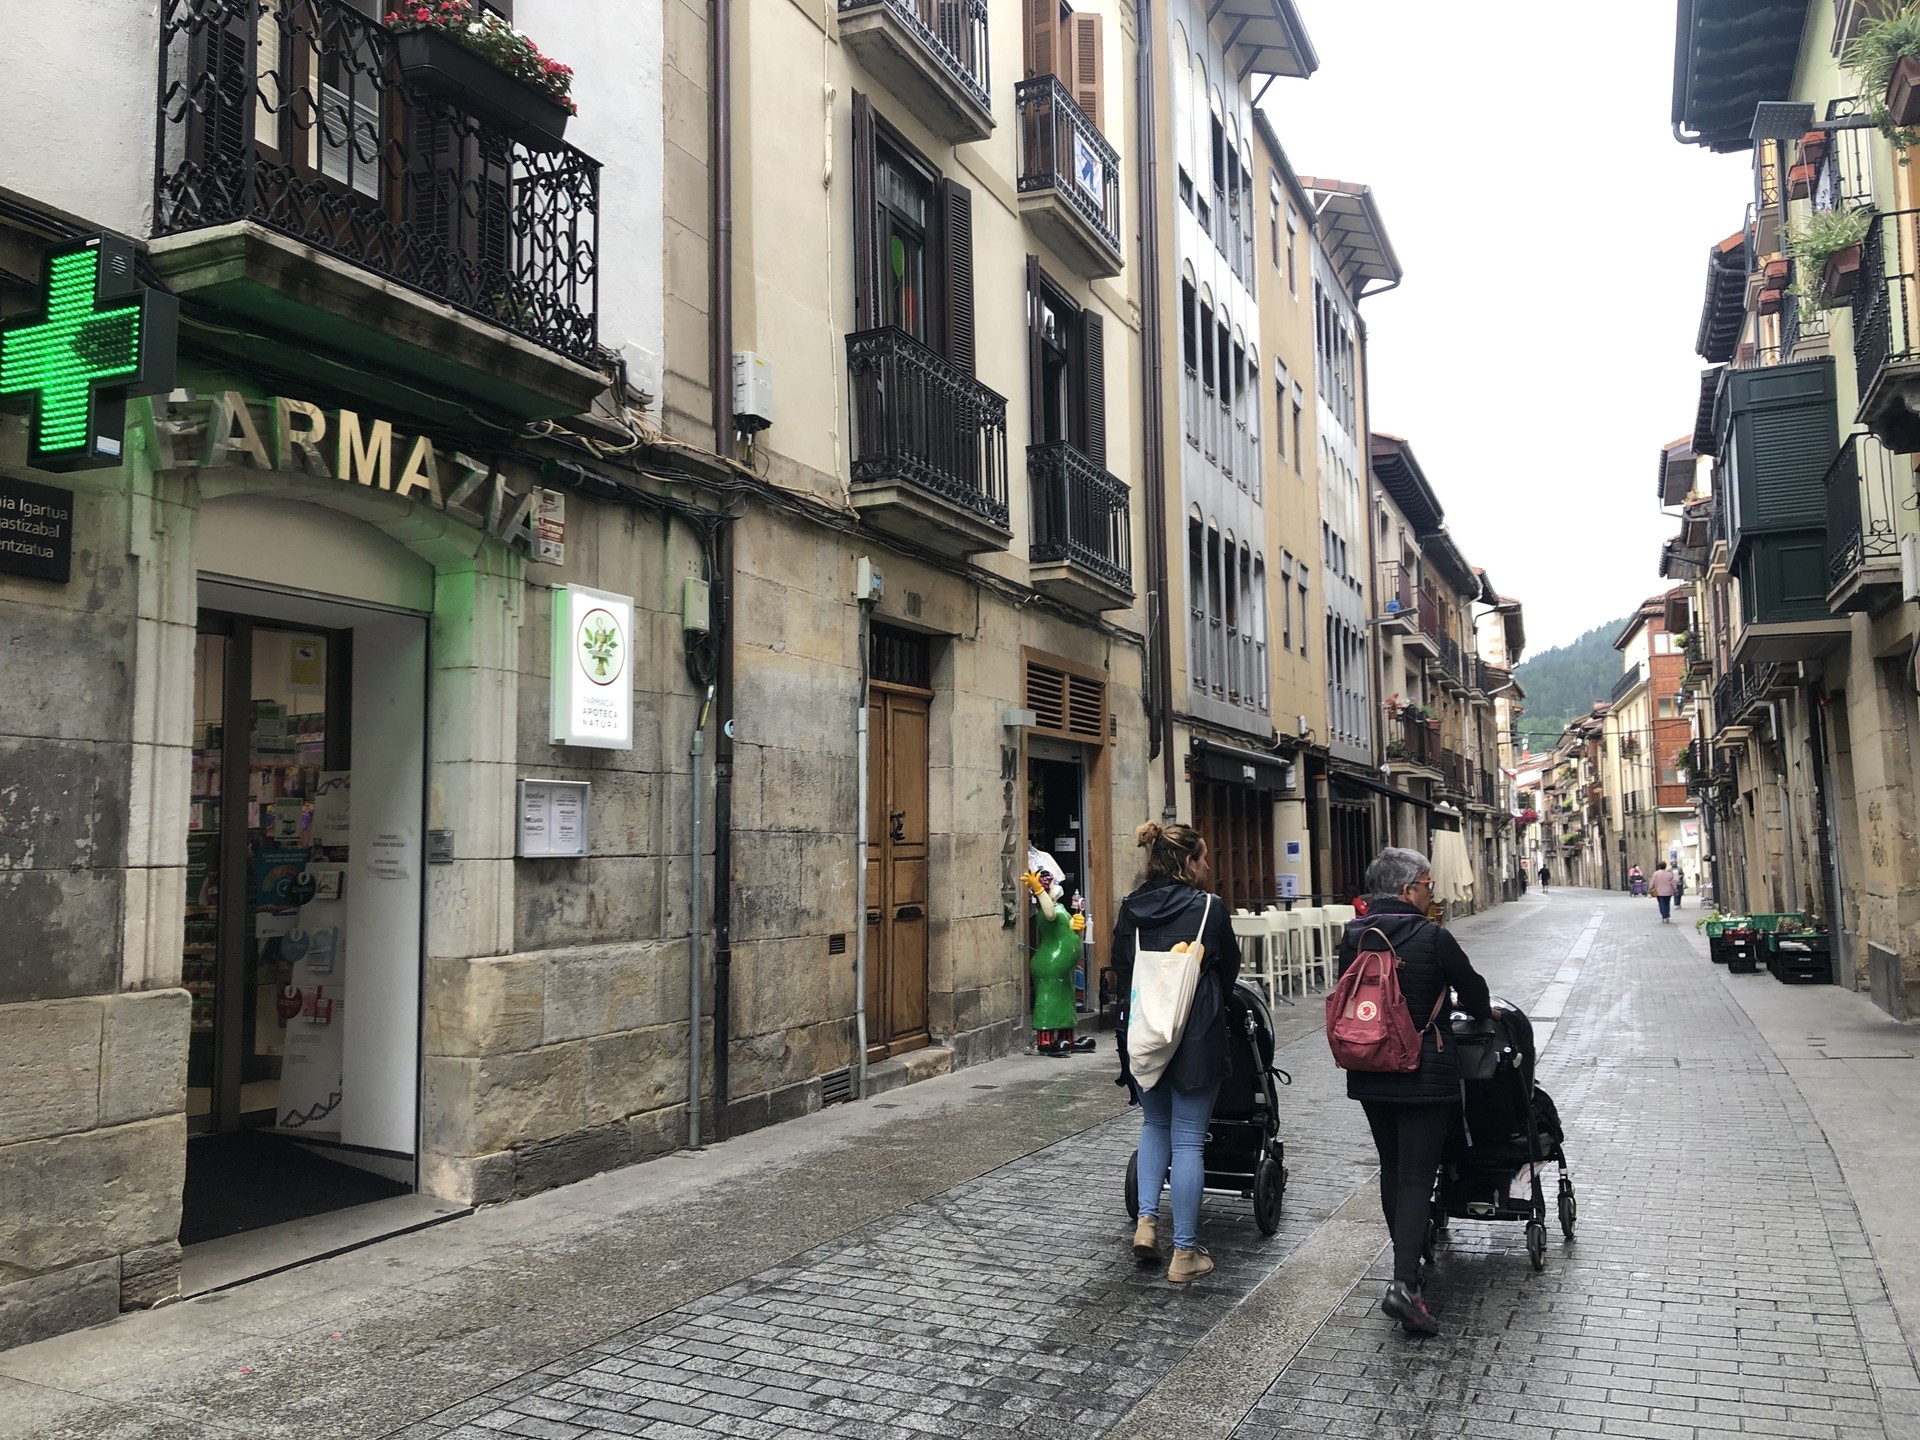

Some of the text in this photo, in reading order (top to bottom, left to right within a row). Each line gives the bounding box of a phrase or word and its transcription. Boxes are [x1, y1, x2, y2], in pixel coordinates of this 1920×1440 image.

[0, 494, 68, 519] ia Igartua
[0, 518, 60, 538] astizabal
